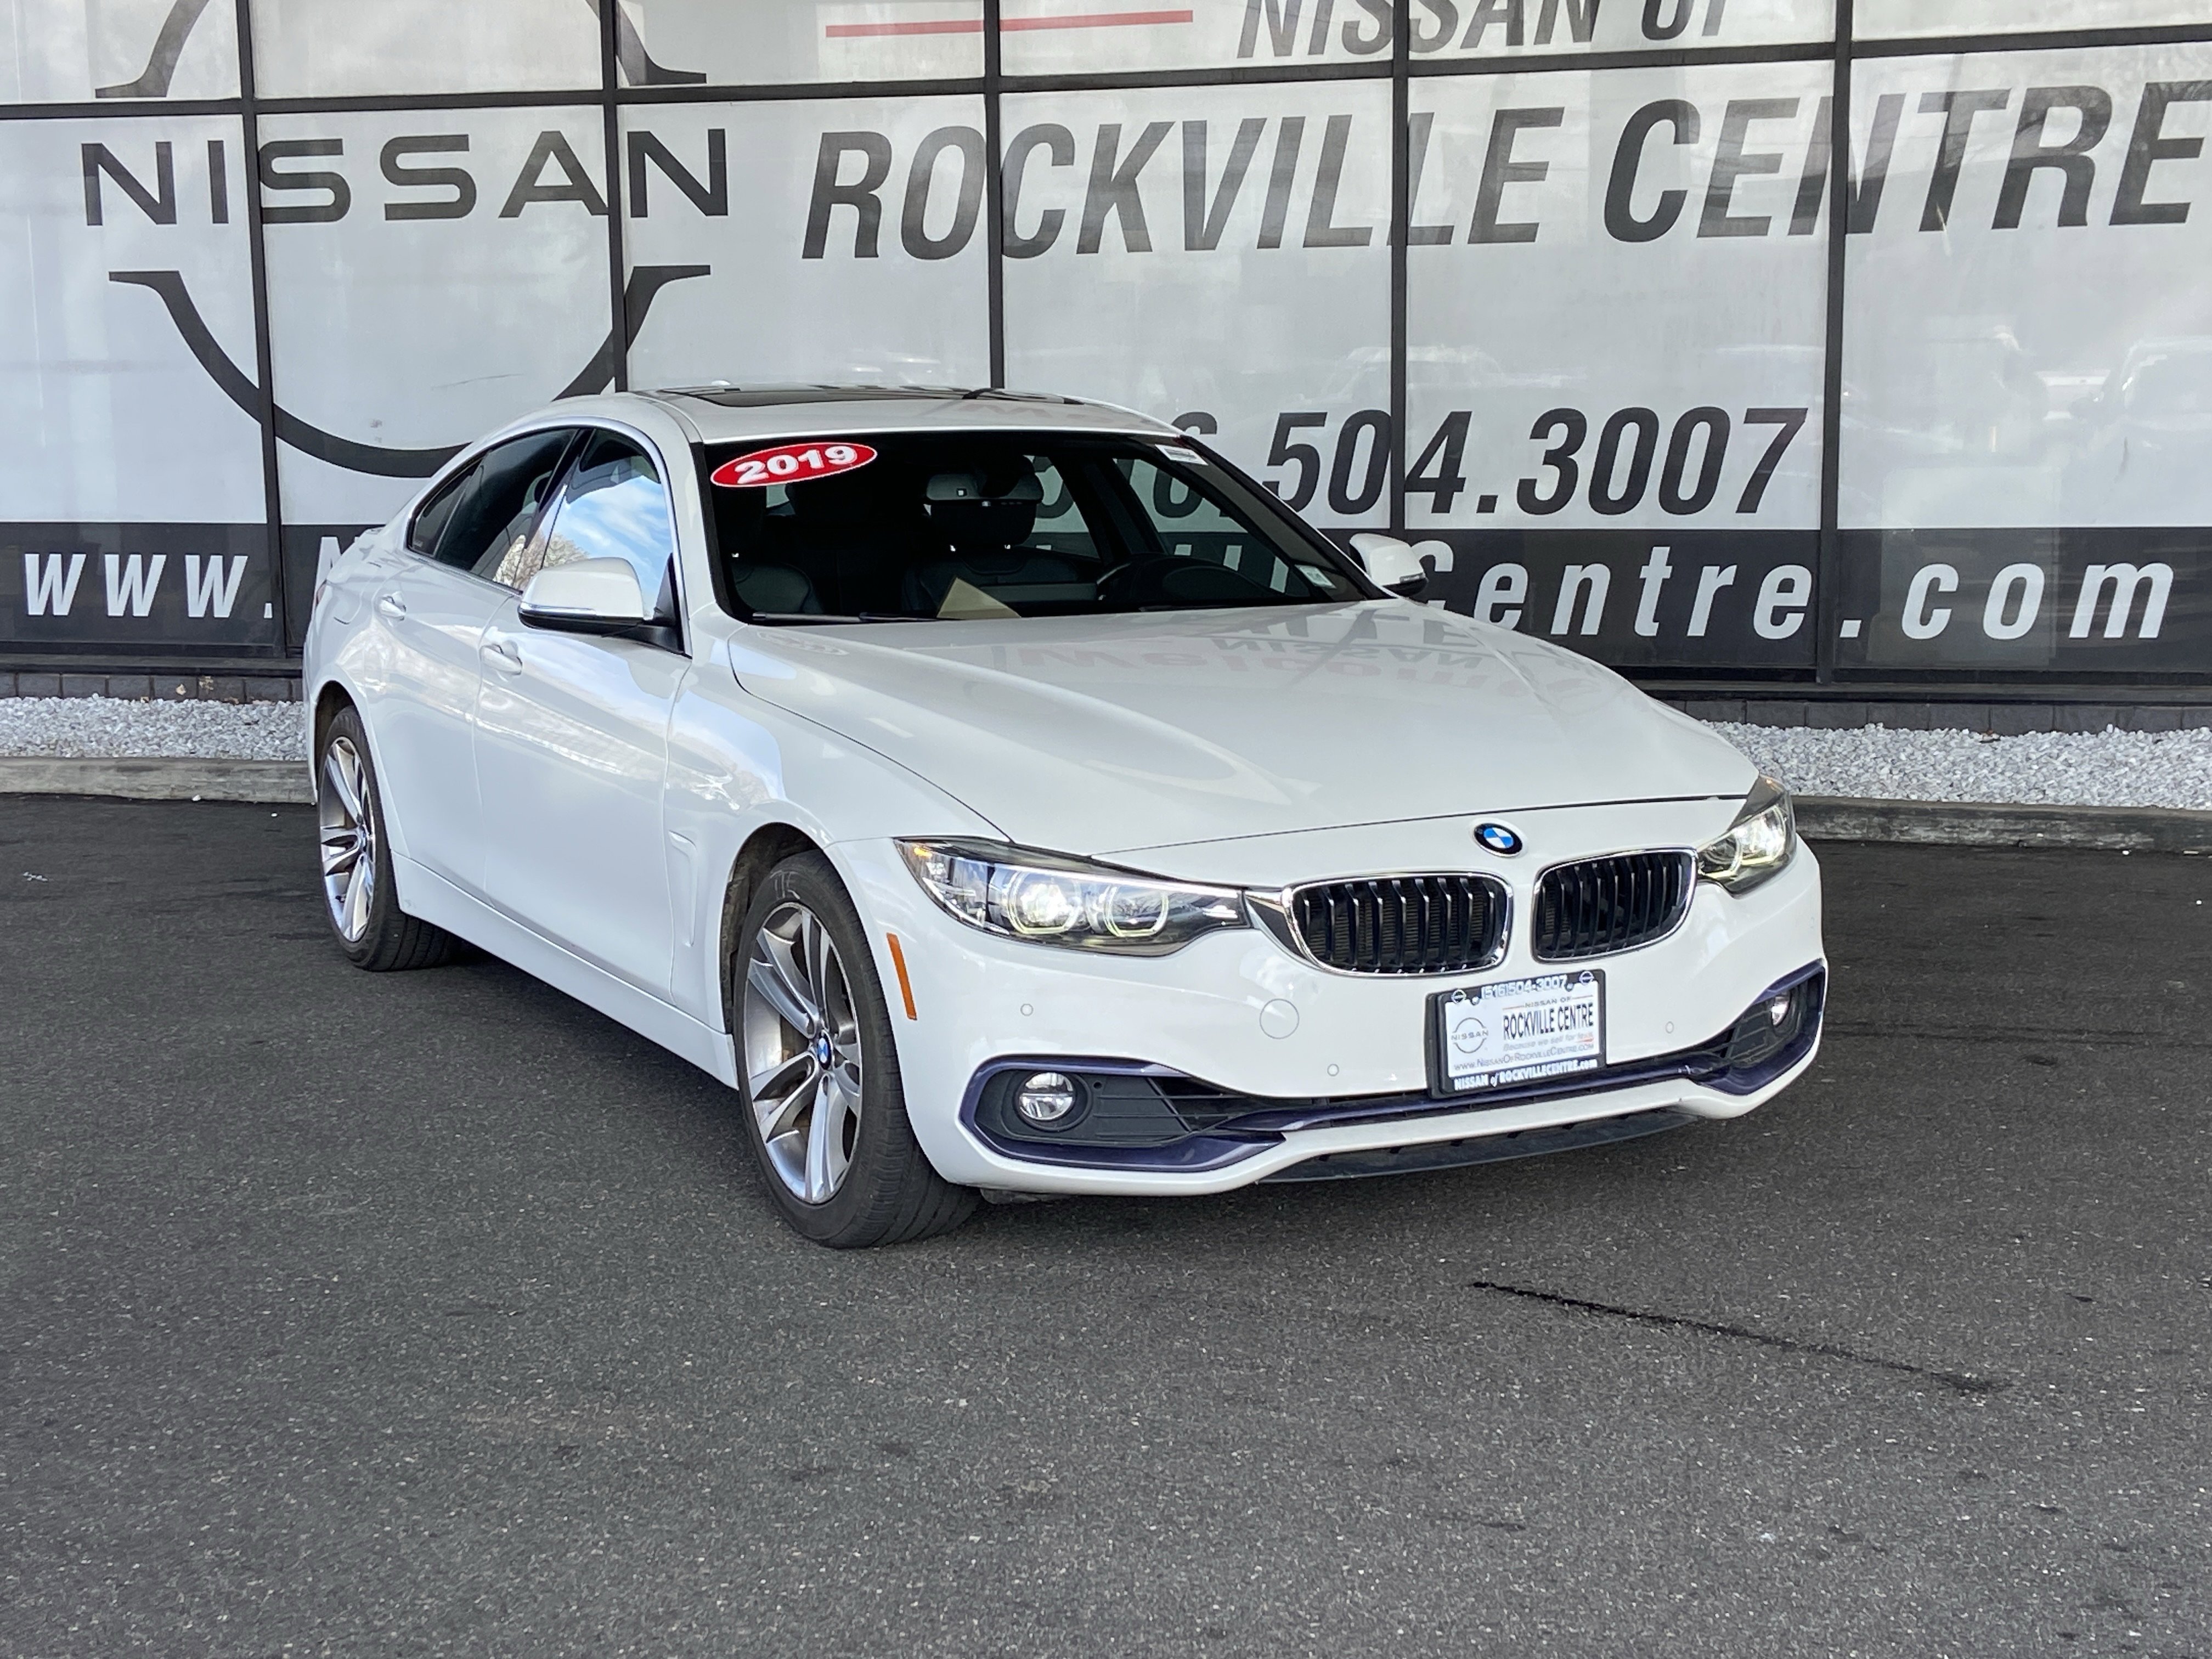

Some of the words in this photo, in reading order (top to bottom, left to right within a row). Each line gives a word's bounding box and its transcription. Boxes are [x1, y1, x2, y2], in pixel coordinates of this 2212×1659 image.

[81, 128, 729, 227] NISSAN
[802, 107, 1565, 261] ROCKVILLE
[1603, 80, 2212, 243] CENTRE
[734, 445, 857, 484] 2019
[1503, 1008, 1555, 1040] ROCKVILLE
[1558, 1002, 1594, 1032] CENTRE
[1525, 998, 1557, 1008] NISSAN
[1451, 1030, 1489, 1040] NISSAN
[1454, 1074, 1488, 1090] NISSAN
